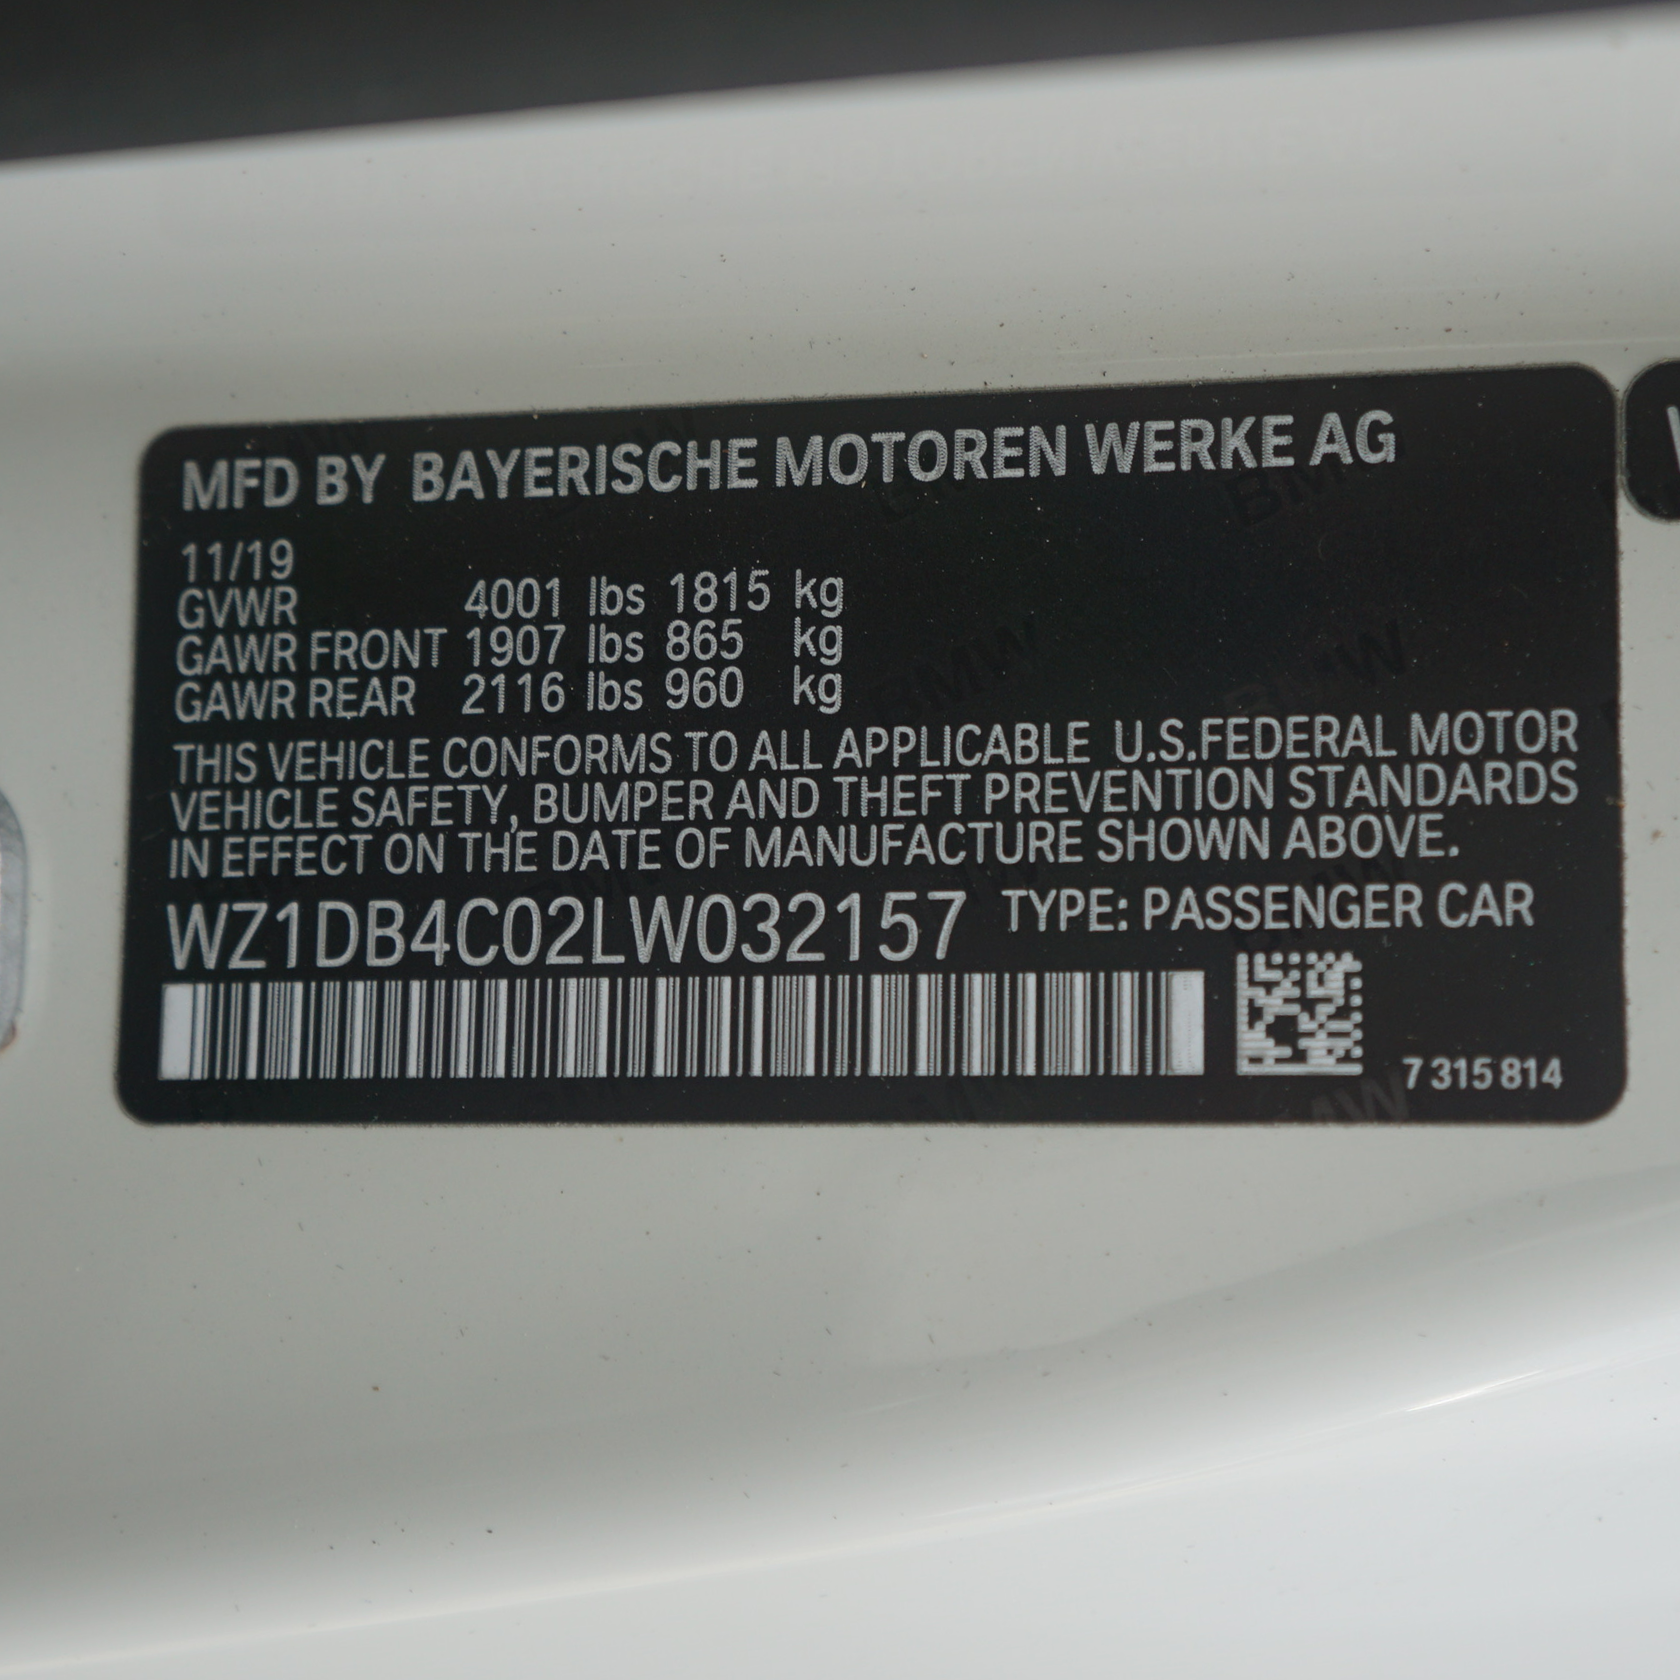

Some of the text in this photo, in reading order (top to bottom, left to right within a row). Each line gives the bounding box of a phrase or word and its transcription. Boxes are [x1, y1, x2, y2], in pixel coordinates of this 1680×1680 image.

[185, 410, 1395, 509] MFD BY BAYERISCHE MOTOREN WERKE AG
[185, 540, 292, 579] 11/19
[180, 569, 843, 628] GVWR 4001 lbs 1815 kg
[178, 618, 842, 675] GAWR FRONT 1907 lbs 865 kg
[177, 666, 841, 722] GAWR REAR 2116 lbs 960 kg
[174, 743, 256, 782] THIS
[269, 739, 429, 781] VEHICLE
[444, 732, 671, 778] CONFORMS
[685, 731, 737, 771] TO
[749, 730, 822, 771] ALL
[833, 722, 1090, 769] APPLICABLE
[1411, 709, 1577, 755] MOTOR
[172, 760, 1578, 832] VEHICLE SAFETY, BUMPER AND THEFT PREVENTION STANDARDS
[171, 814, 1458, 877] IN EFFECT ON THE DATE OF MANUFACTURE SHOWN ABOVE.
[168, 891, 966, 969] WZ1DB4C02LW032157
[1002, 888, 1127, 931] TYPE:
[1145, 884, 1422, 930] PASSENGER
[1438, 882, 1533, 927] CAR
